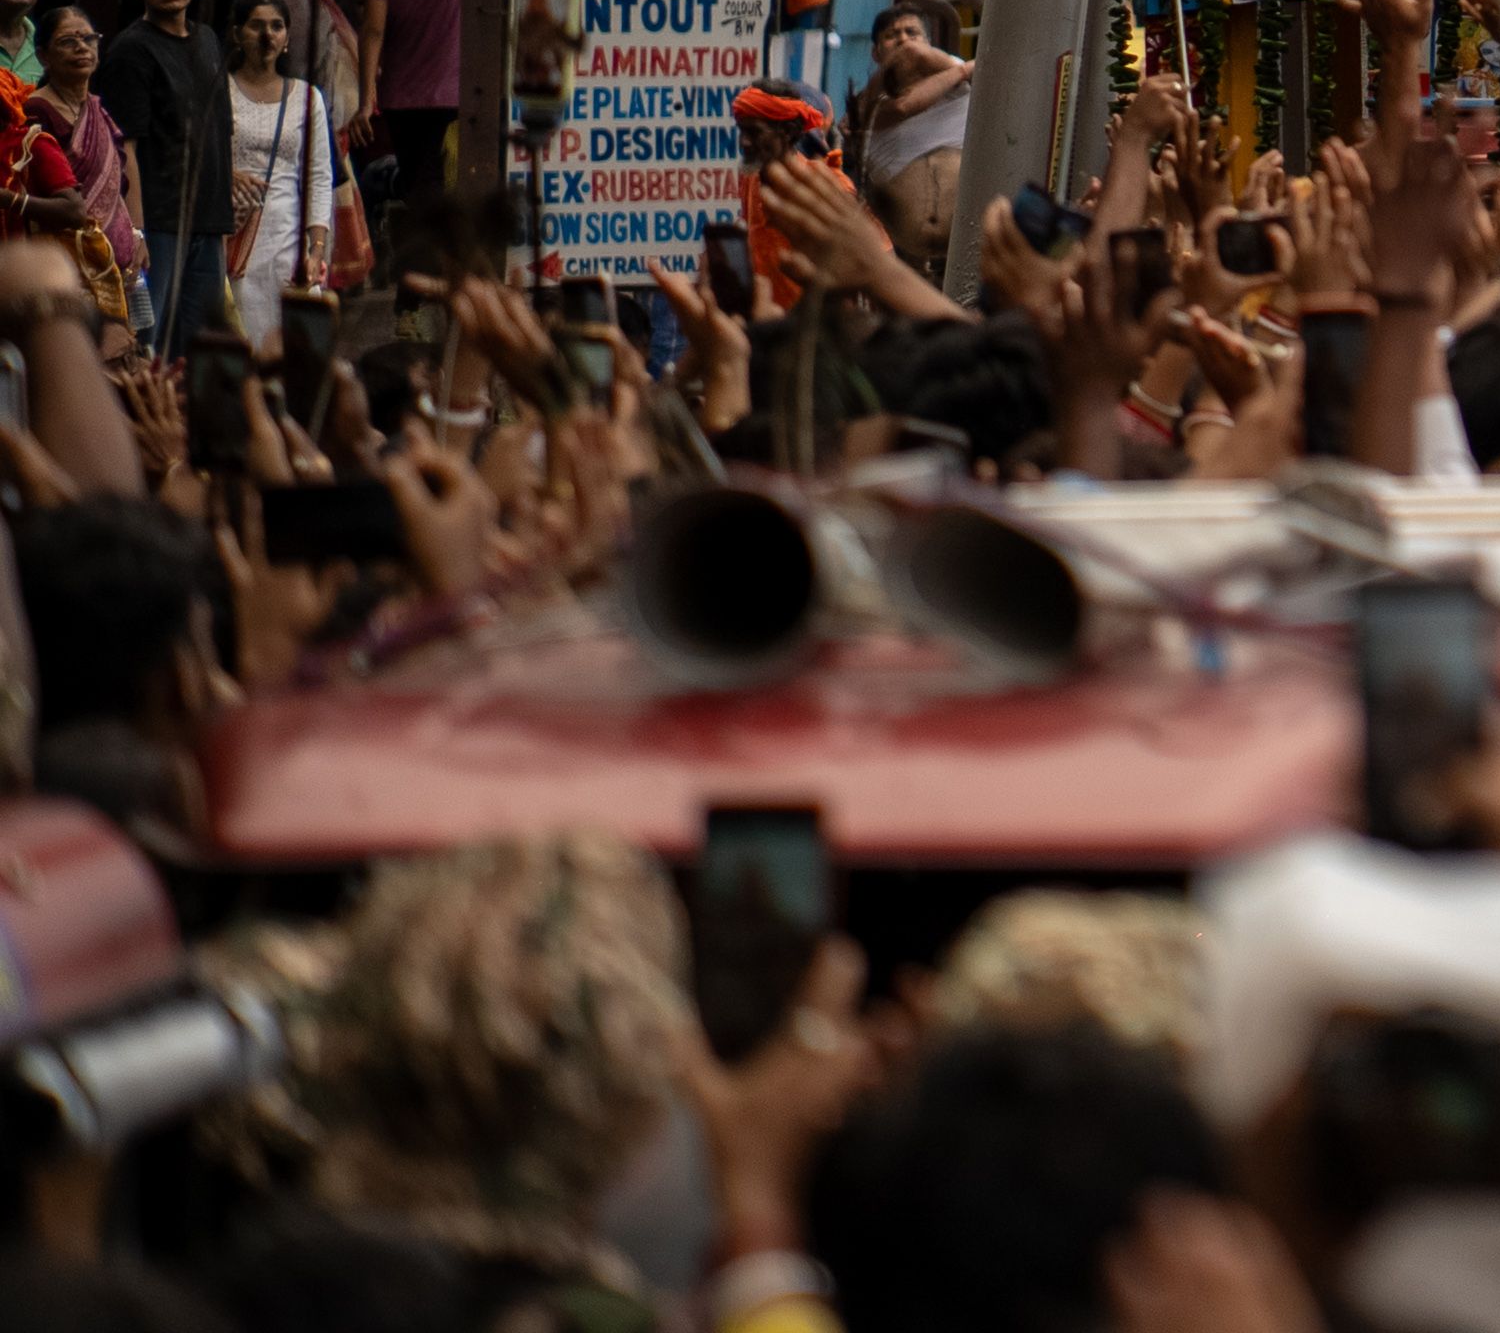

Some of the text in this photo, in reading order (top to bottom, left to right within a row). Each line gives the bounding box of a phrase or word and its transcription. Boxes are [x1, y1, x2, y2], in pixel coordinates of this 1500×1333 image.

[574, 45, 758, 77] LAMINATION
[682, 84, 739, 119] VINY
[590, 125, 744, 162] DESIGNIN
[696, 167, 744, 201] STA
[585, 211, 648, 244] SIGN
[654, 208, 743, 242] BOAR
[565, 253, 697, 276] CHITRALKHA
